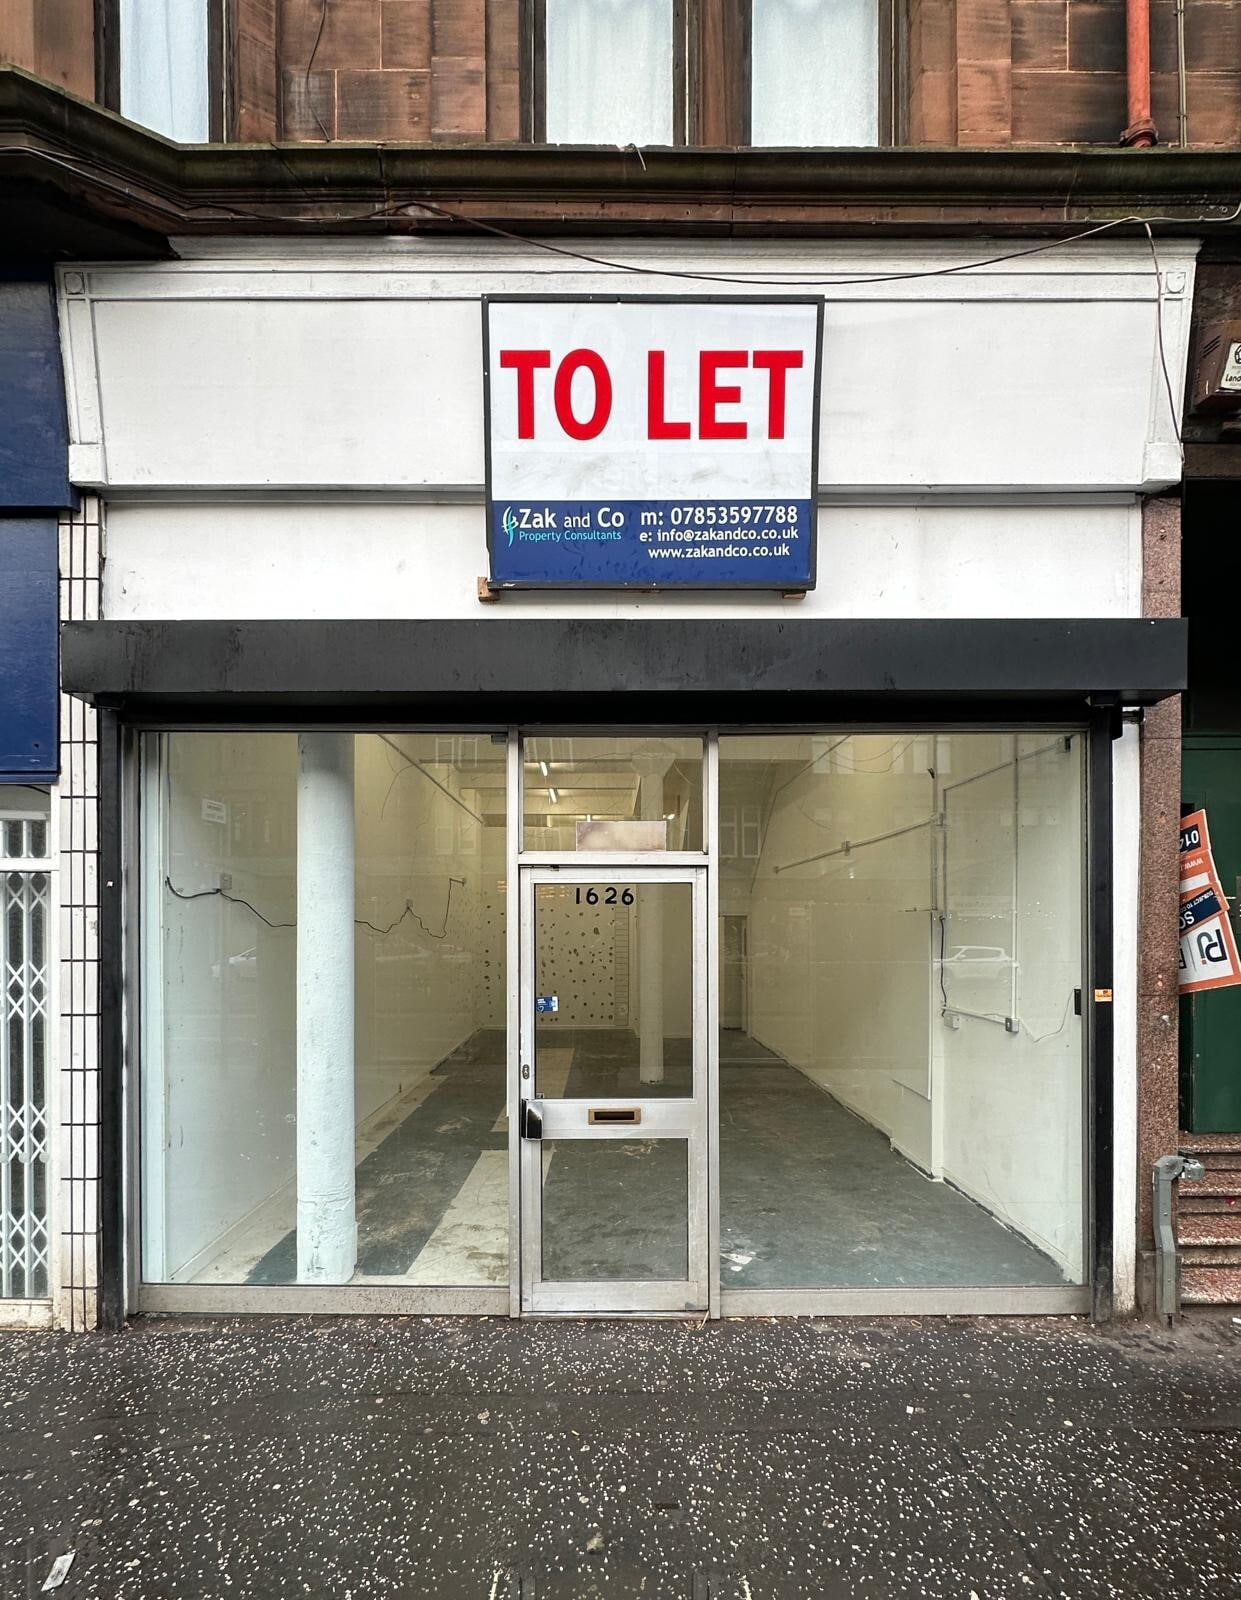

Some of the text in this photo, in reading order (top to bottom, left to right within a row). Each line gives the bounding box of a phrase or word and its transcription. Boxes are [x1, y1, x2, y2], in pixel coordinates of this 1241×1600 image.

[500, 348, 803, 441] TO LET
[519, 507, 625, 528] Zak and Co
[640, 505, 798, 526] m: 07853597788
[519, 530, 622, 543] Property Consultants
[639, 526, 799, 542] e: info@zakandco.co.uk
[648, 543, 790, 559] www.zakandco.co.uk
[575, 886, 635, 906] 1626
